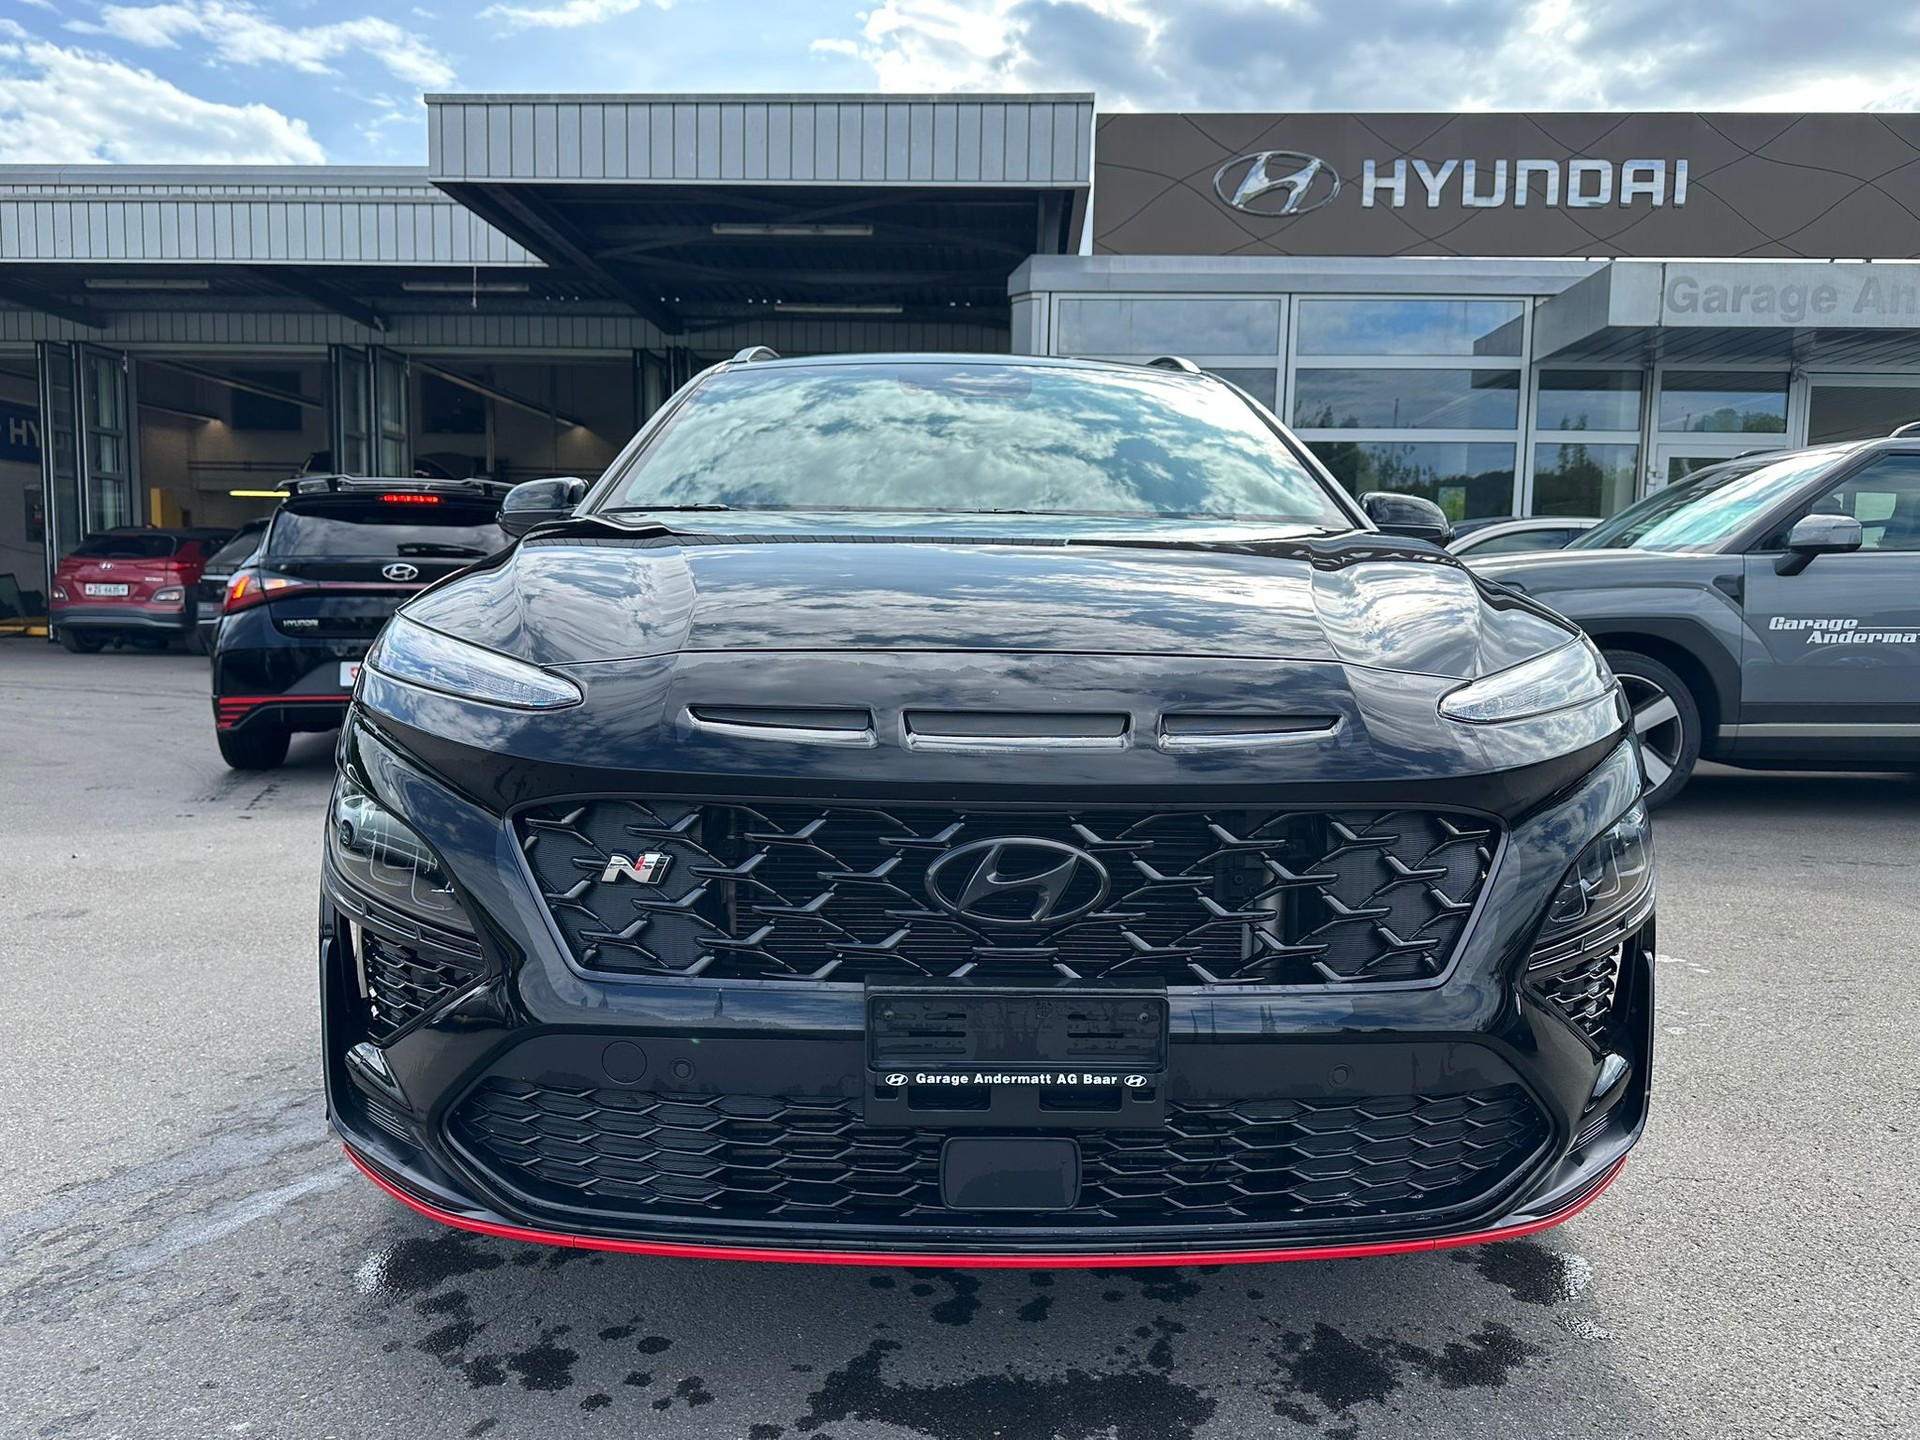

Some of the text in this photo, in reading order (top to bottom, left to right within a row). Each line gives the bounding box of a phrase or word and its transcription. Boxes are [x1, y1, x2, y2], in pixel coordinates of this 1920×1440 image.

[1362, 158, 1688, 208] HYUNDAI
[1665, 275, 1838, 323] Garage
[1769, 616, 1858, 631] Garage
[1806, 630, 1920, 644] Anderma
[915, 1073, 1118, 1086] Garage Andermatt AG Baar
